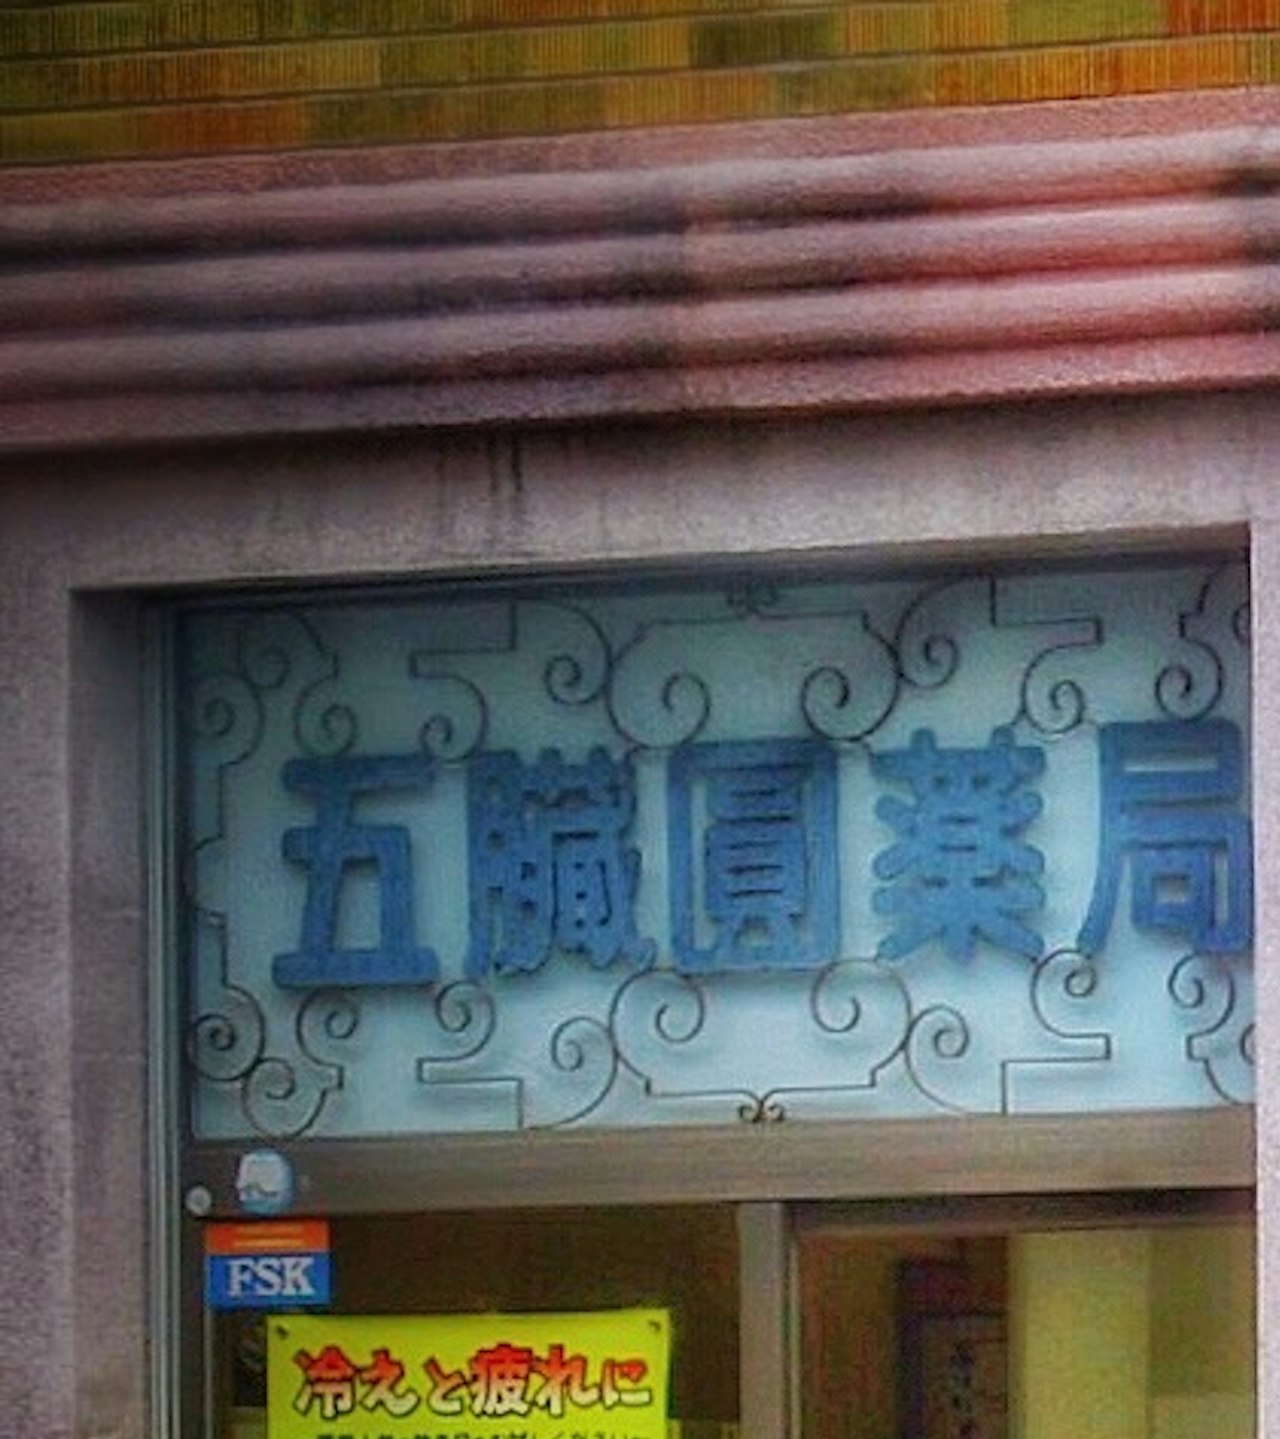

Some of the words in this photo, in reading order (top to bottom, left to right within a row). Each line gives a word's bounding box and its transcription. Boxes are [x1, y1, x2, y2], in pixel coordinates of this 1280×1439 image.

[228, 1256, 316, 1297] FSK
[293, 1343, 652, 1419] 冷えと疲れに
